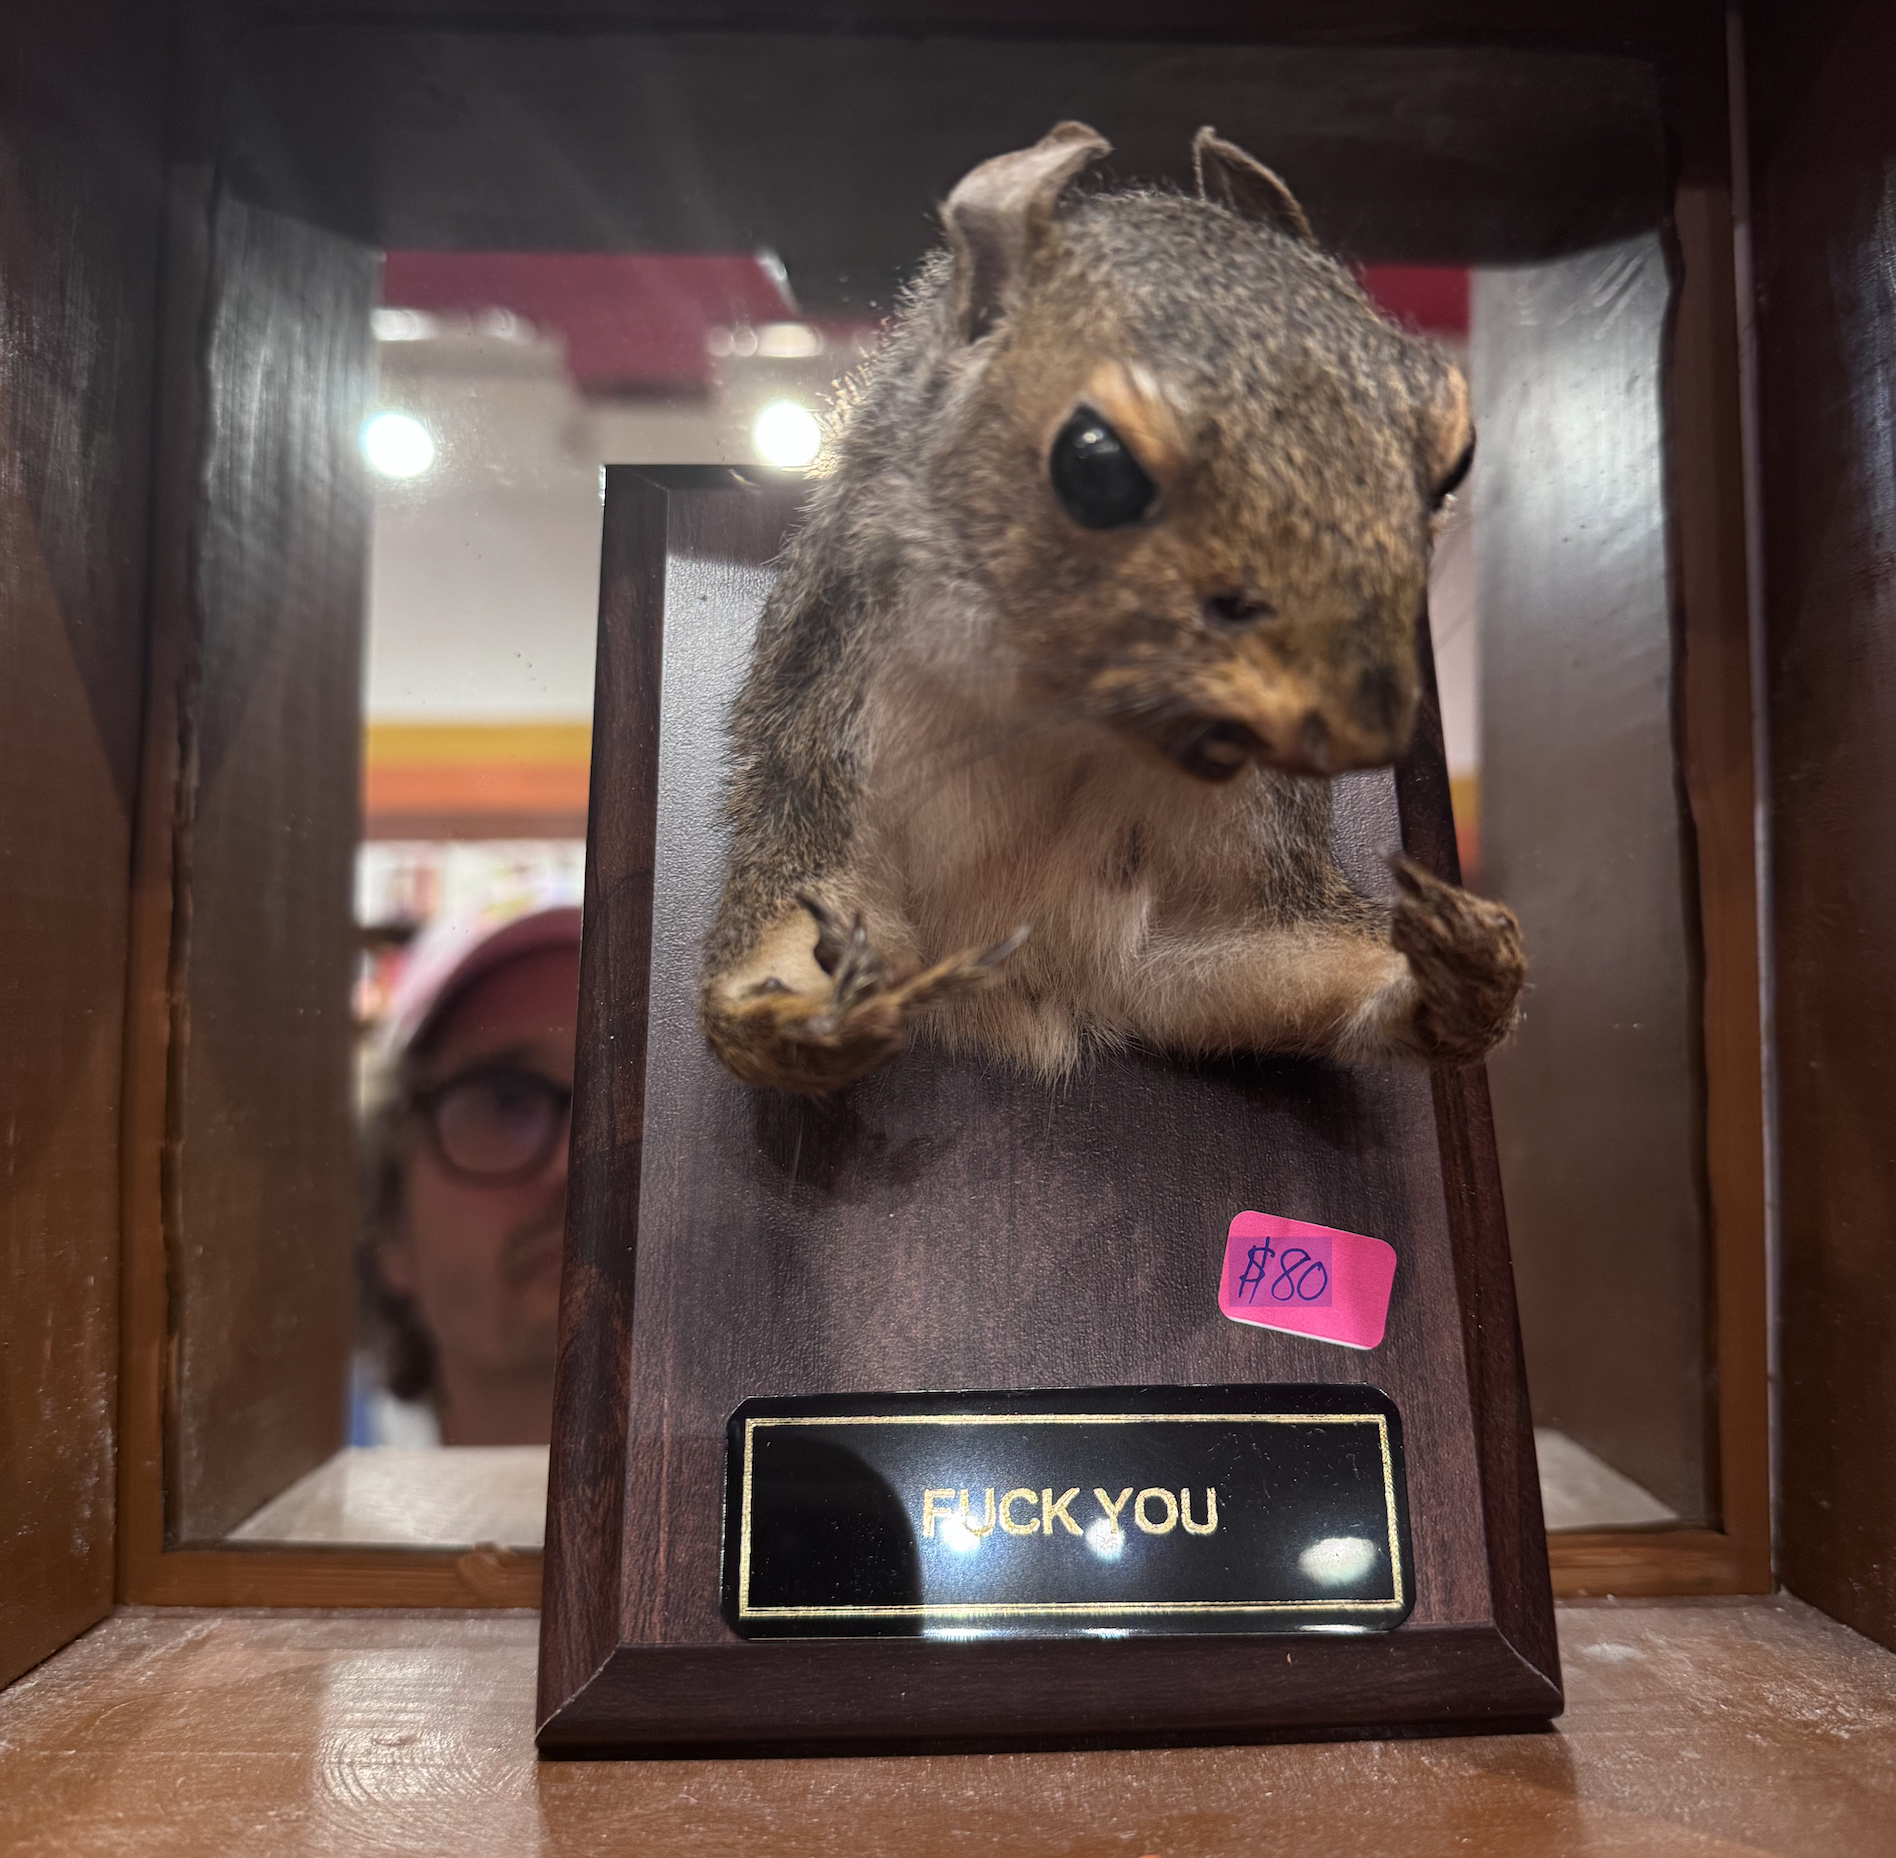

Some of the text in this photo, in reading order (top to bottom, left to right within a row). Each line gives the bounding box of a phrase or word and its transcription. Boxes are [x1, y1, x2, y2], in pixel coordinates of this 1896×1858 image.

[1238, 1236, 1329, 1304] $80
[921, 1486, 1218, 1537] FUCK YOU
